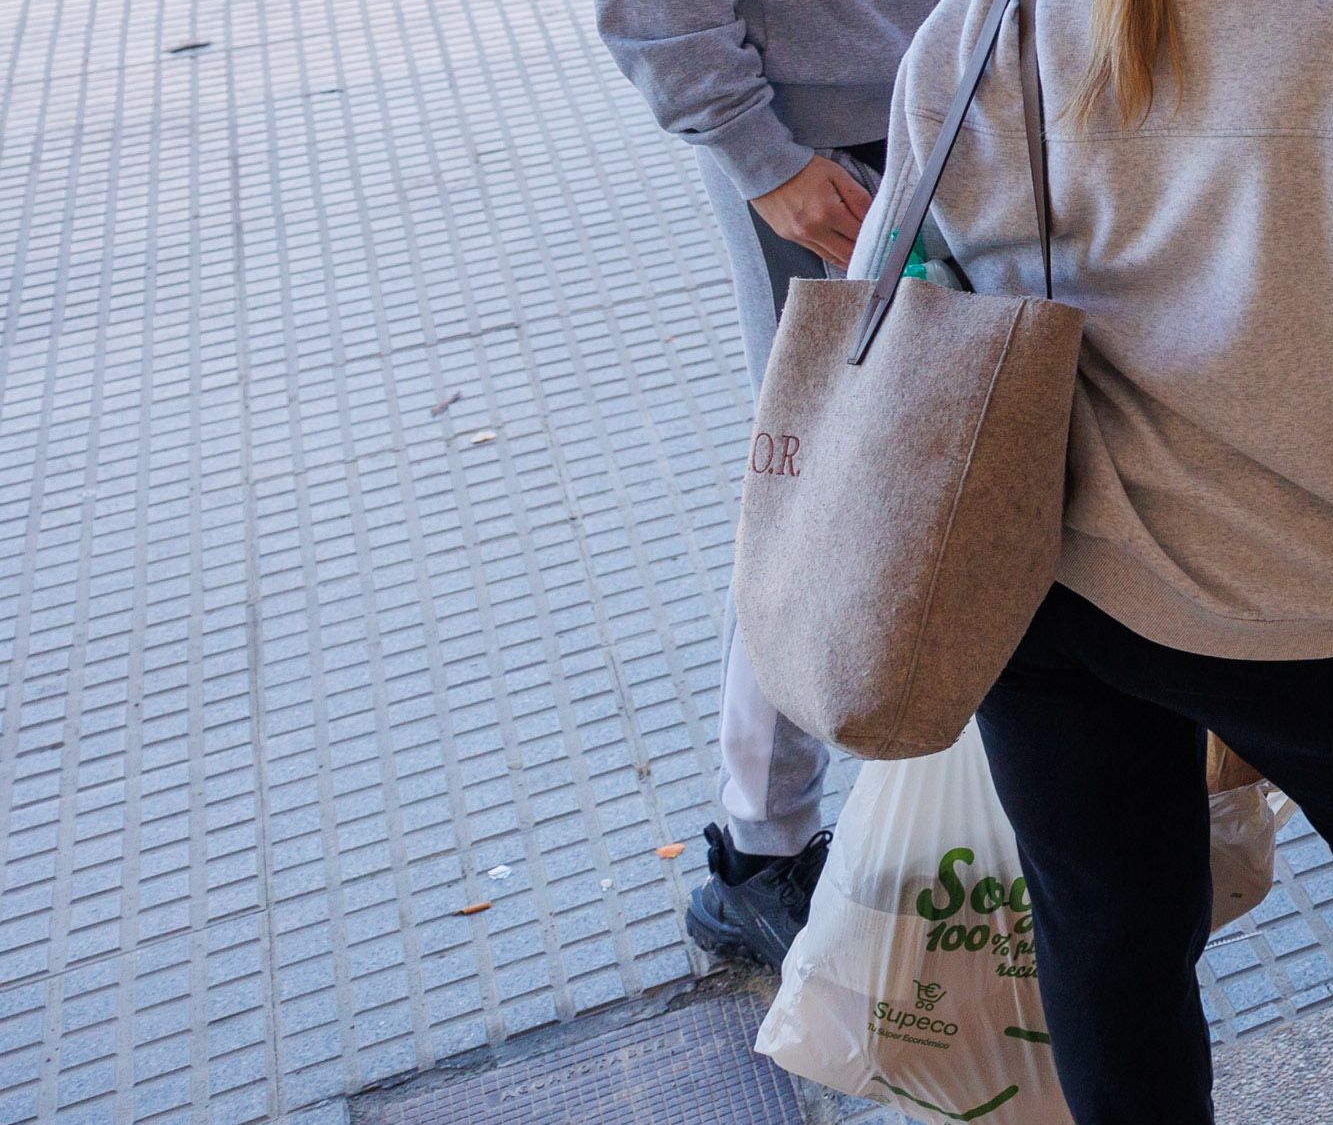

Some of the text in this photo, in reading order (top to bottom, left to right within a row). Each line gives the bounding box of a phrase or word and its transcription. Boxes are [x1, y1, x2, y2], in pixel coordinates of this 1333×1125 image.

[872, 1001, 959, 1036] Supeco
[867, 1022, 877, 1033] Tu
[902, 1034, 951, 1050] Económico
